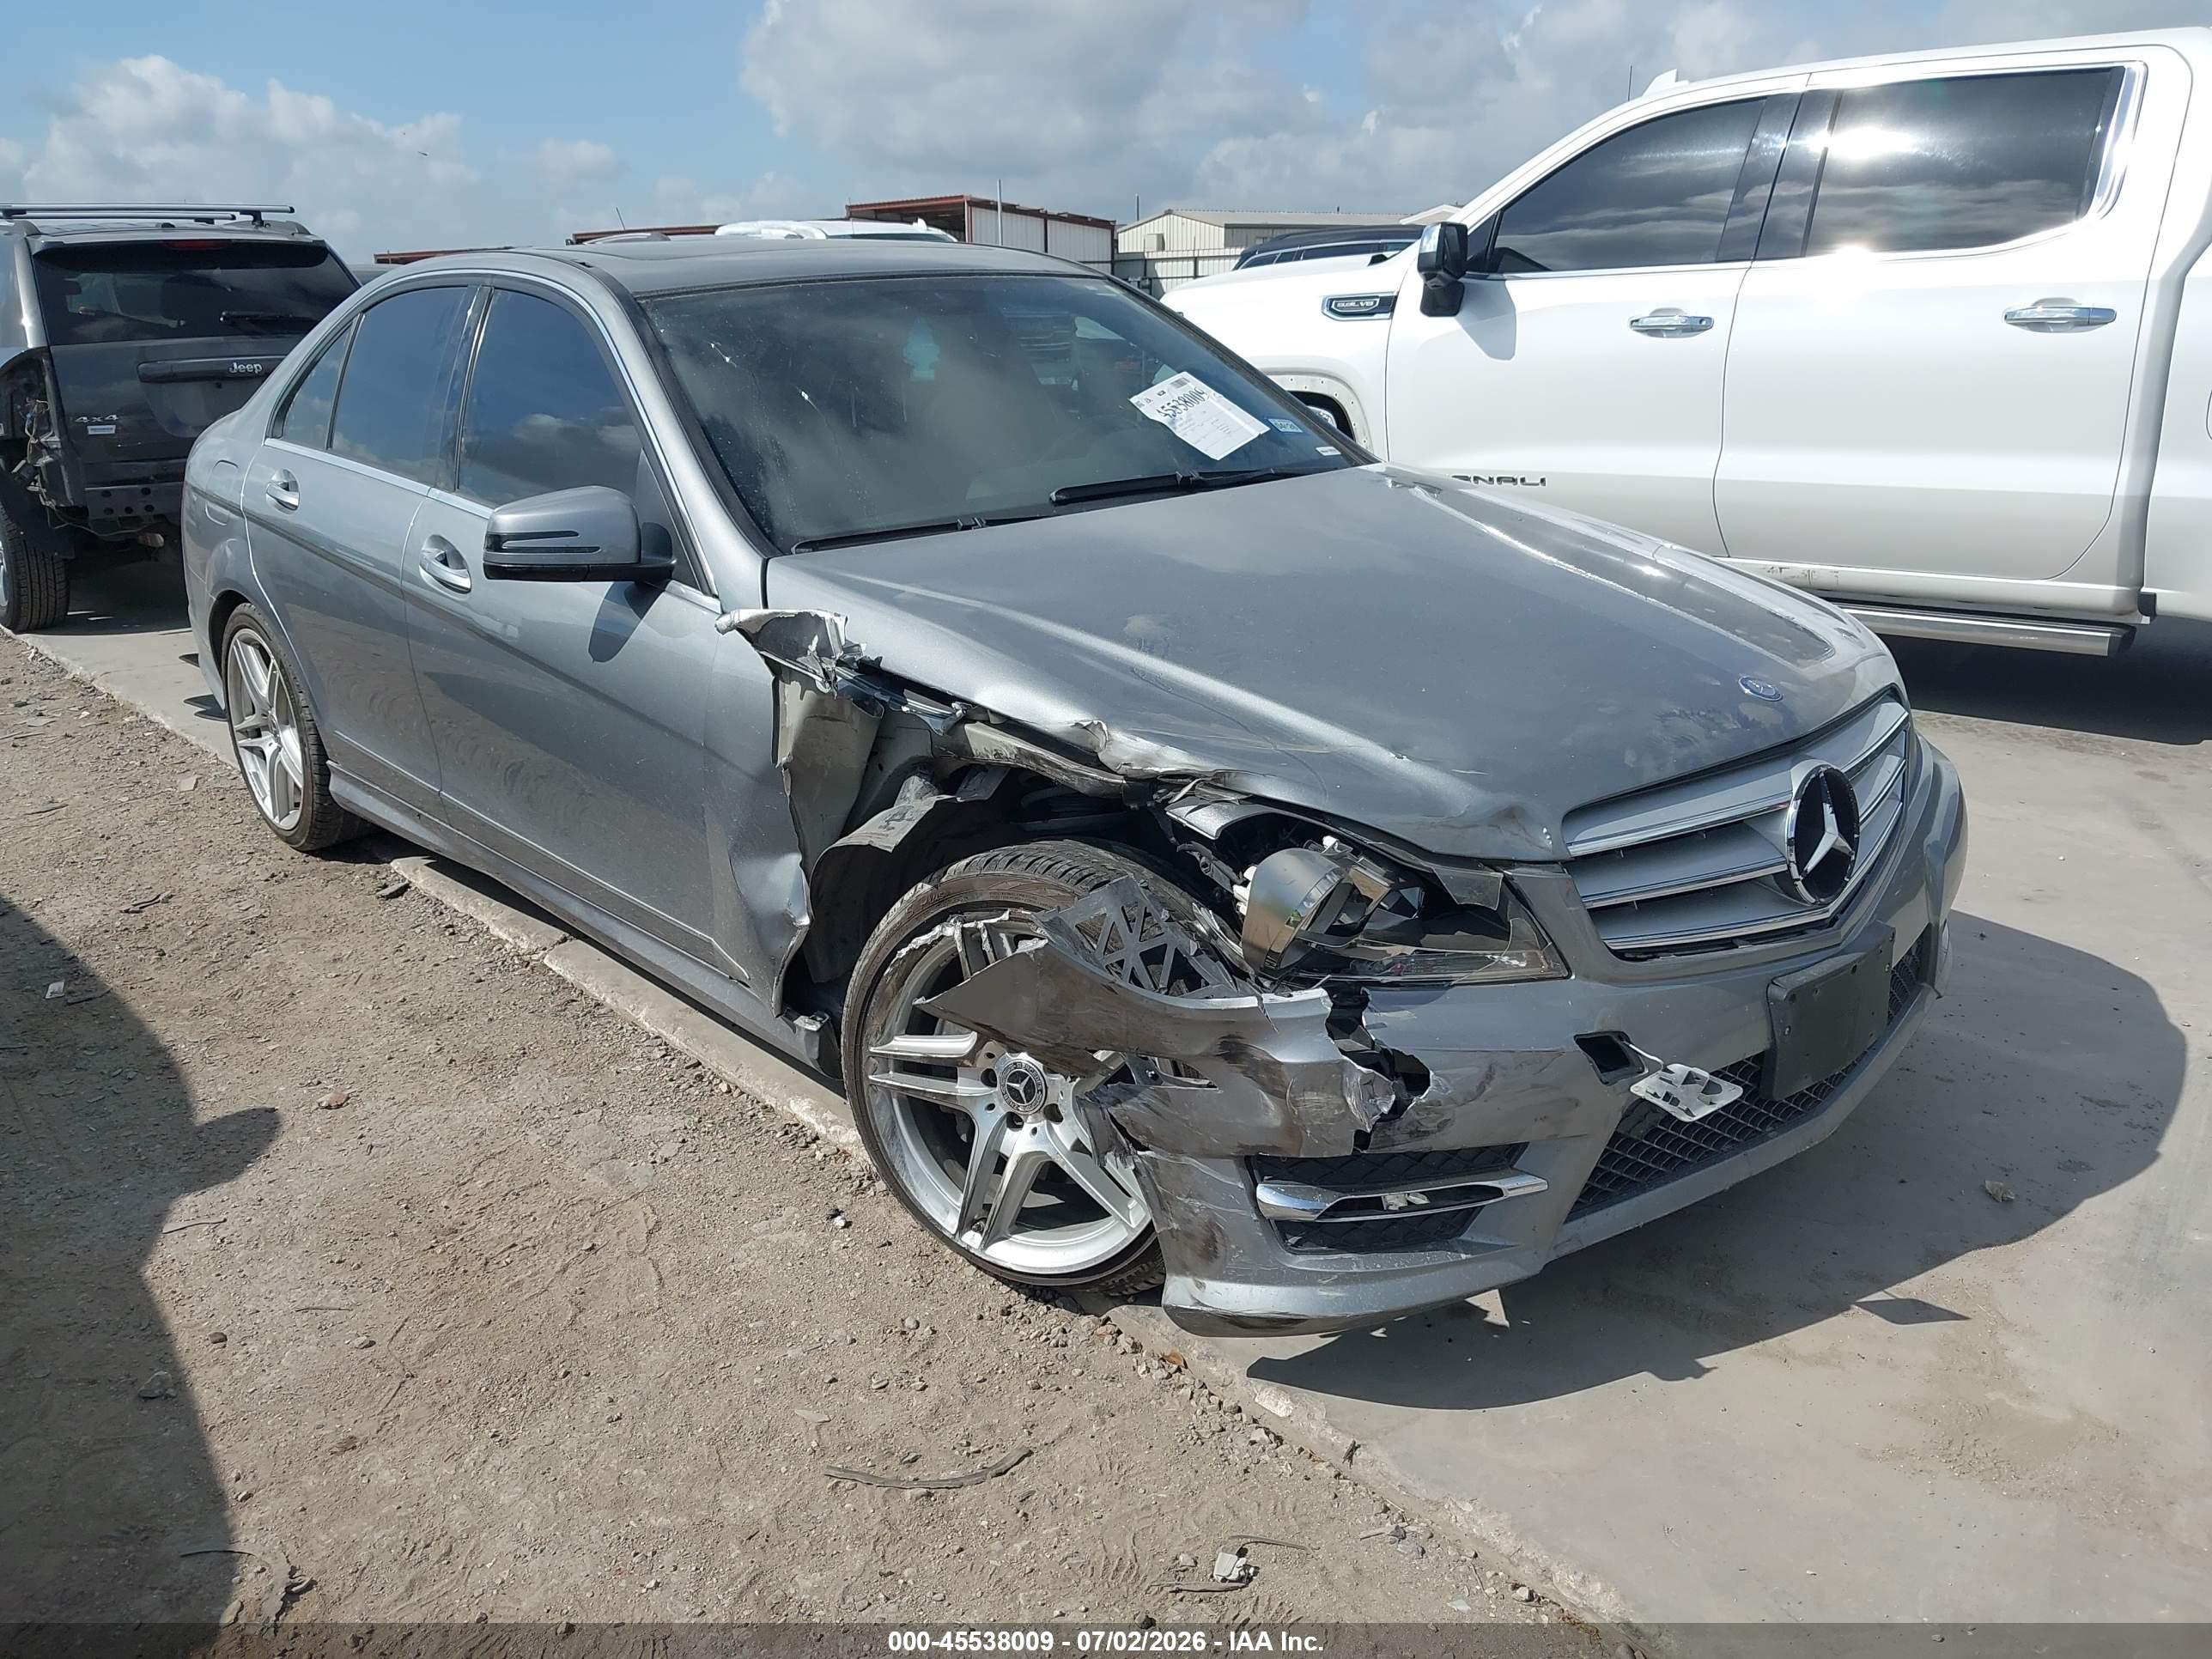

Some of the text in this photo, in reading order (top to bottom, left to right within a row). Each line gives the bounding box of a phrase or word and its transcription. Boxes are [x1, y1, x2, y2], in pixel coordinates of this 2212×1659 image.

[229, 362, 263, 374] Jeep
[75, 414, 119, 422] 4x4
[1451, 475, 1547, 487] NALI
[1016, 1062, 1042, 1091] MERCEDES
[1003, 1093, 1019, 1111] BENZ
